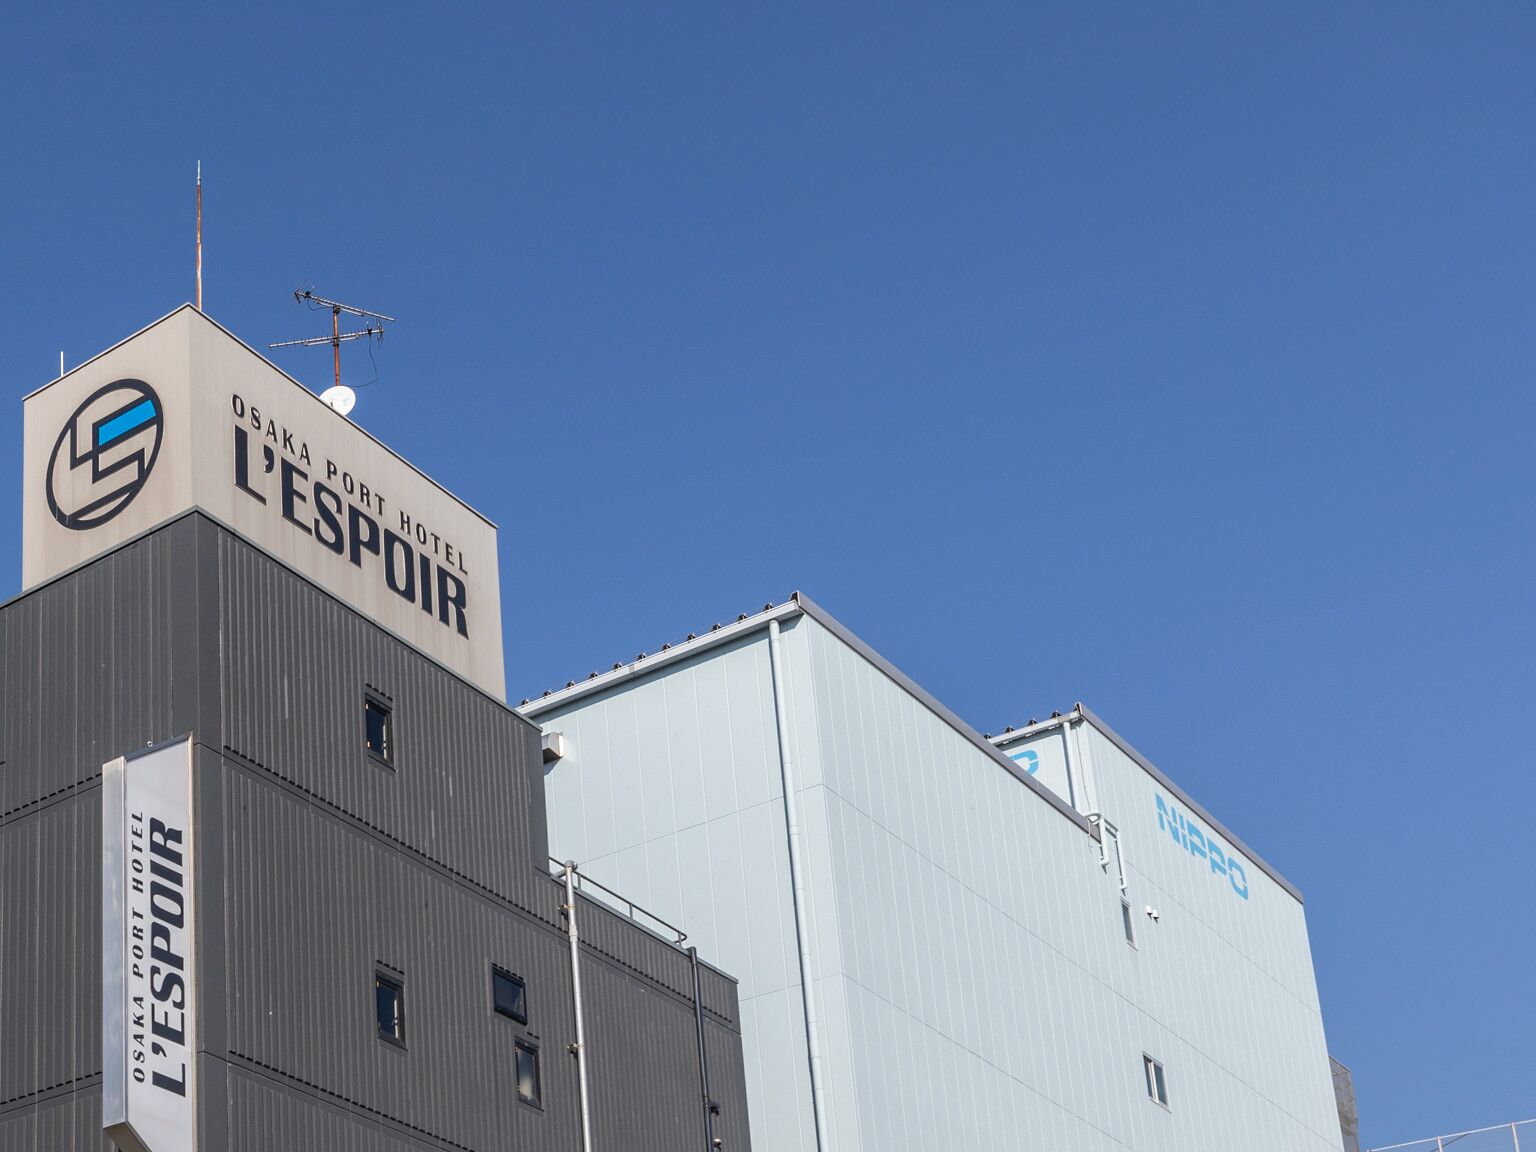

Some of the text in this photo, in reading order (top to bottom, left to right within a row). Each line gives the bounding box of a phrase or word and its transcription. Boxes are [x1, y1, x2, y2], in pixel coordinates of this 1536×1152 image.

[230, 393, 469, 576] OSAKA PORT HOTEL
[233, 424, 470, 640] L'ESPOIR
[131, 812, 146, 1083] OSAKA PORT HOTEL
[1155, 793, 1248, 900] NIPPO
[149, 817, 187, 1098] L'ESPOIR
